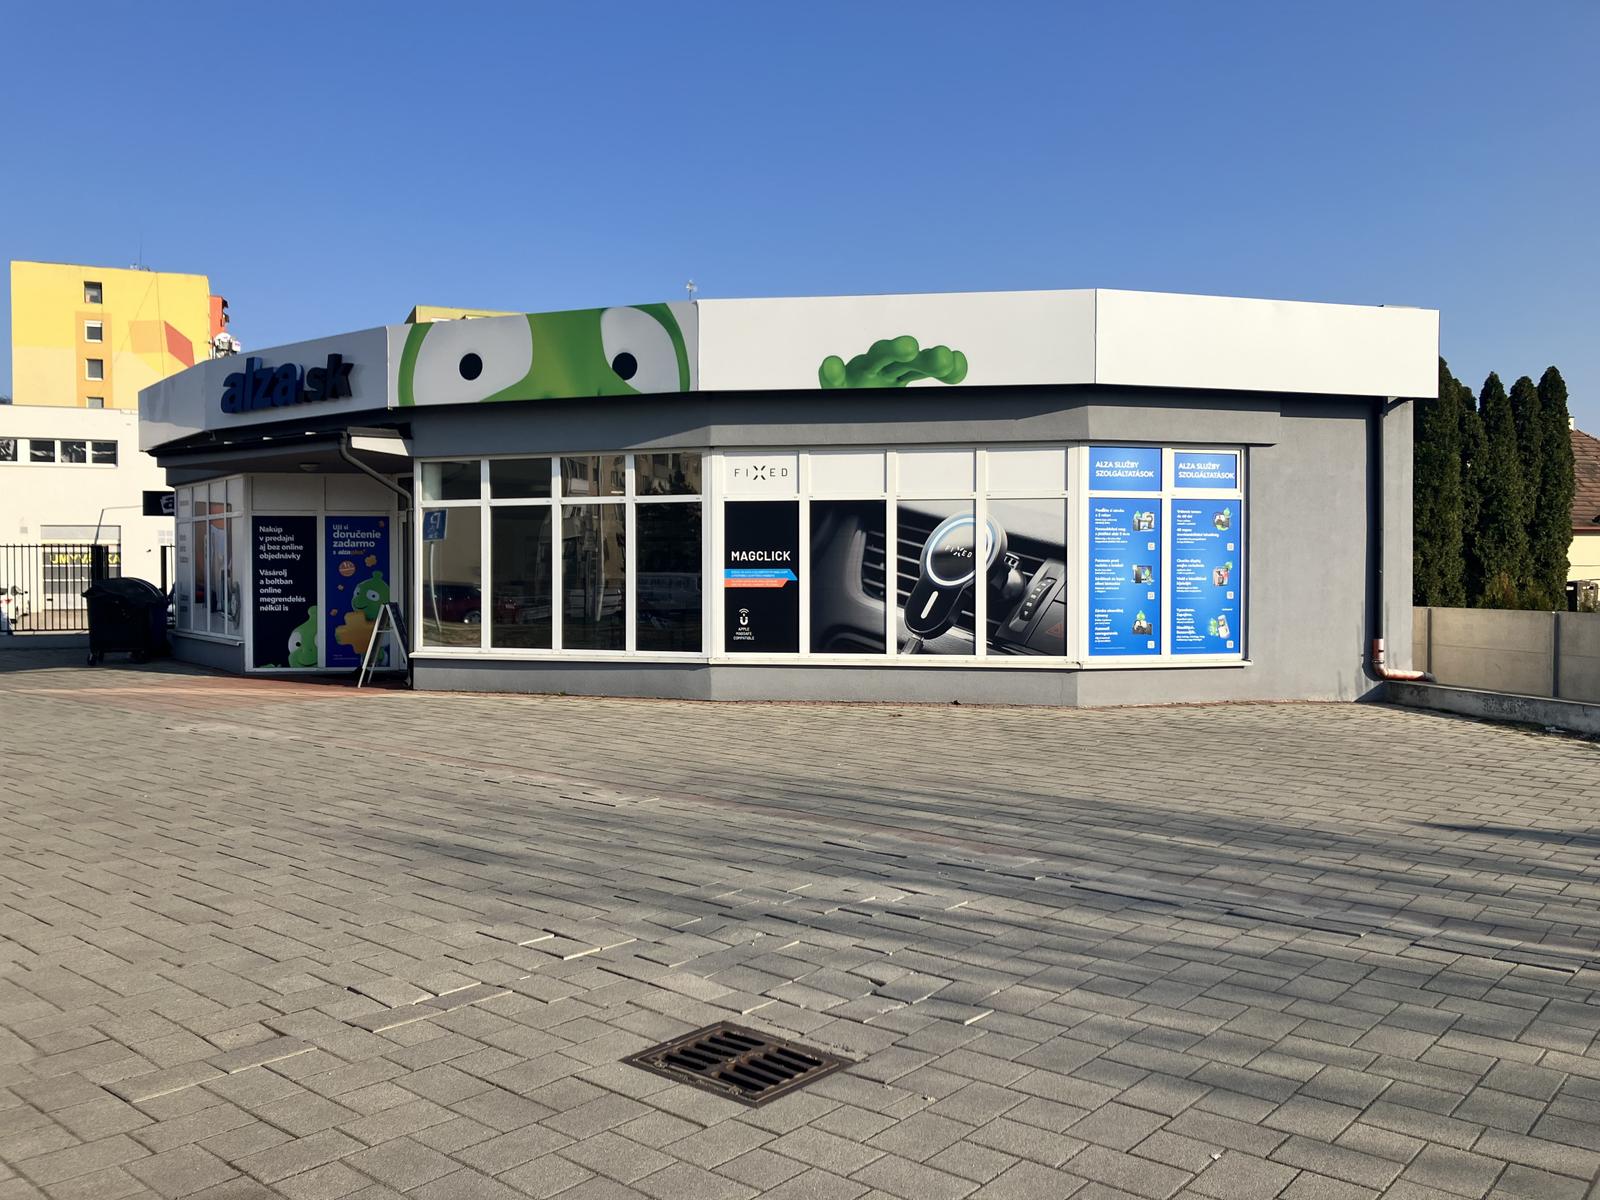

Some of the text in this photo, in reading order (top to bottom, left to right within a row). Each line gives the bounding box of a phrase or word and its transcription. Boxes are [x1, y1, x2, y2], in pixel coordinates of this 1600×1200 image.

[221, 353, 354, 413] alza.sk
[1095, 460, 1139, 469] ALZA SLUŽBY
[1197, 461, 1220, 470] SLUŽBY
[734, 465, 788, 480] FIXED
[1095, 469, 1154, 478] SZOLGÁLTATÁSOK
[1178, 471, 1235, 479] SZOLGÁLTATÁSOK
[259, 526, 283, 534] Nakúp
[333, 530, 381, 538] doručenie
[265, 535, 294, 543] predajni
[333, 539, 376, 547] zadarmo
[259, 544, 266, 552] aj
[731, 551, 791, 561] MAGCLICK
[259, 569, 287, 577] Vásárolj
[259, 596, 306, 604] megrendelés
